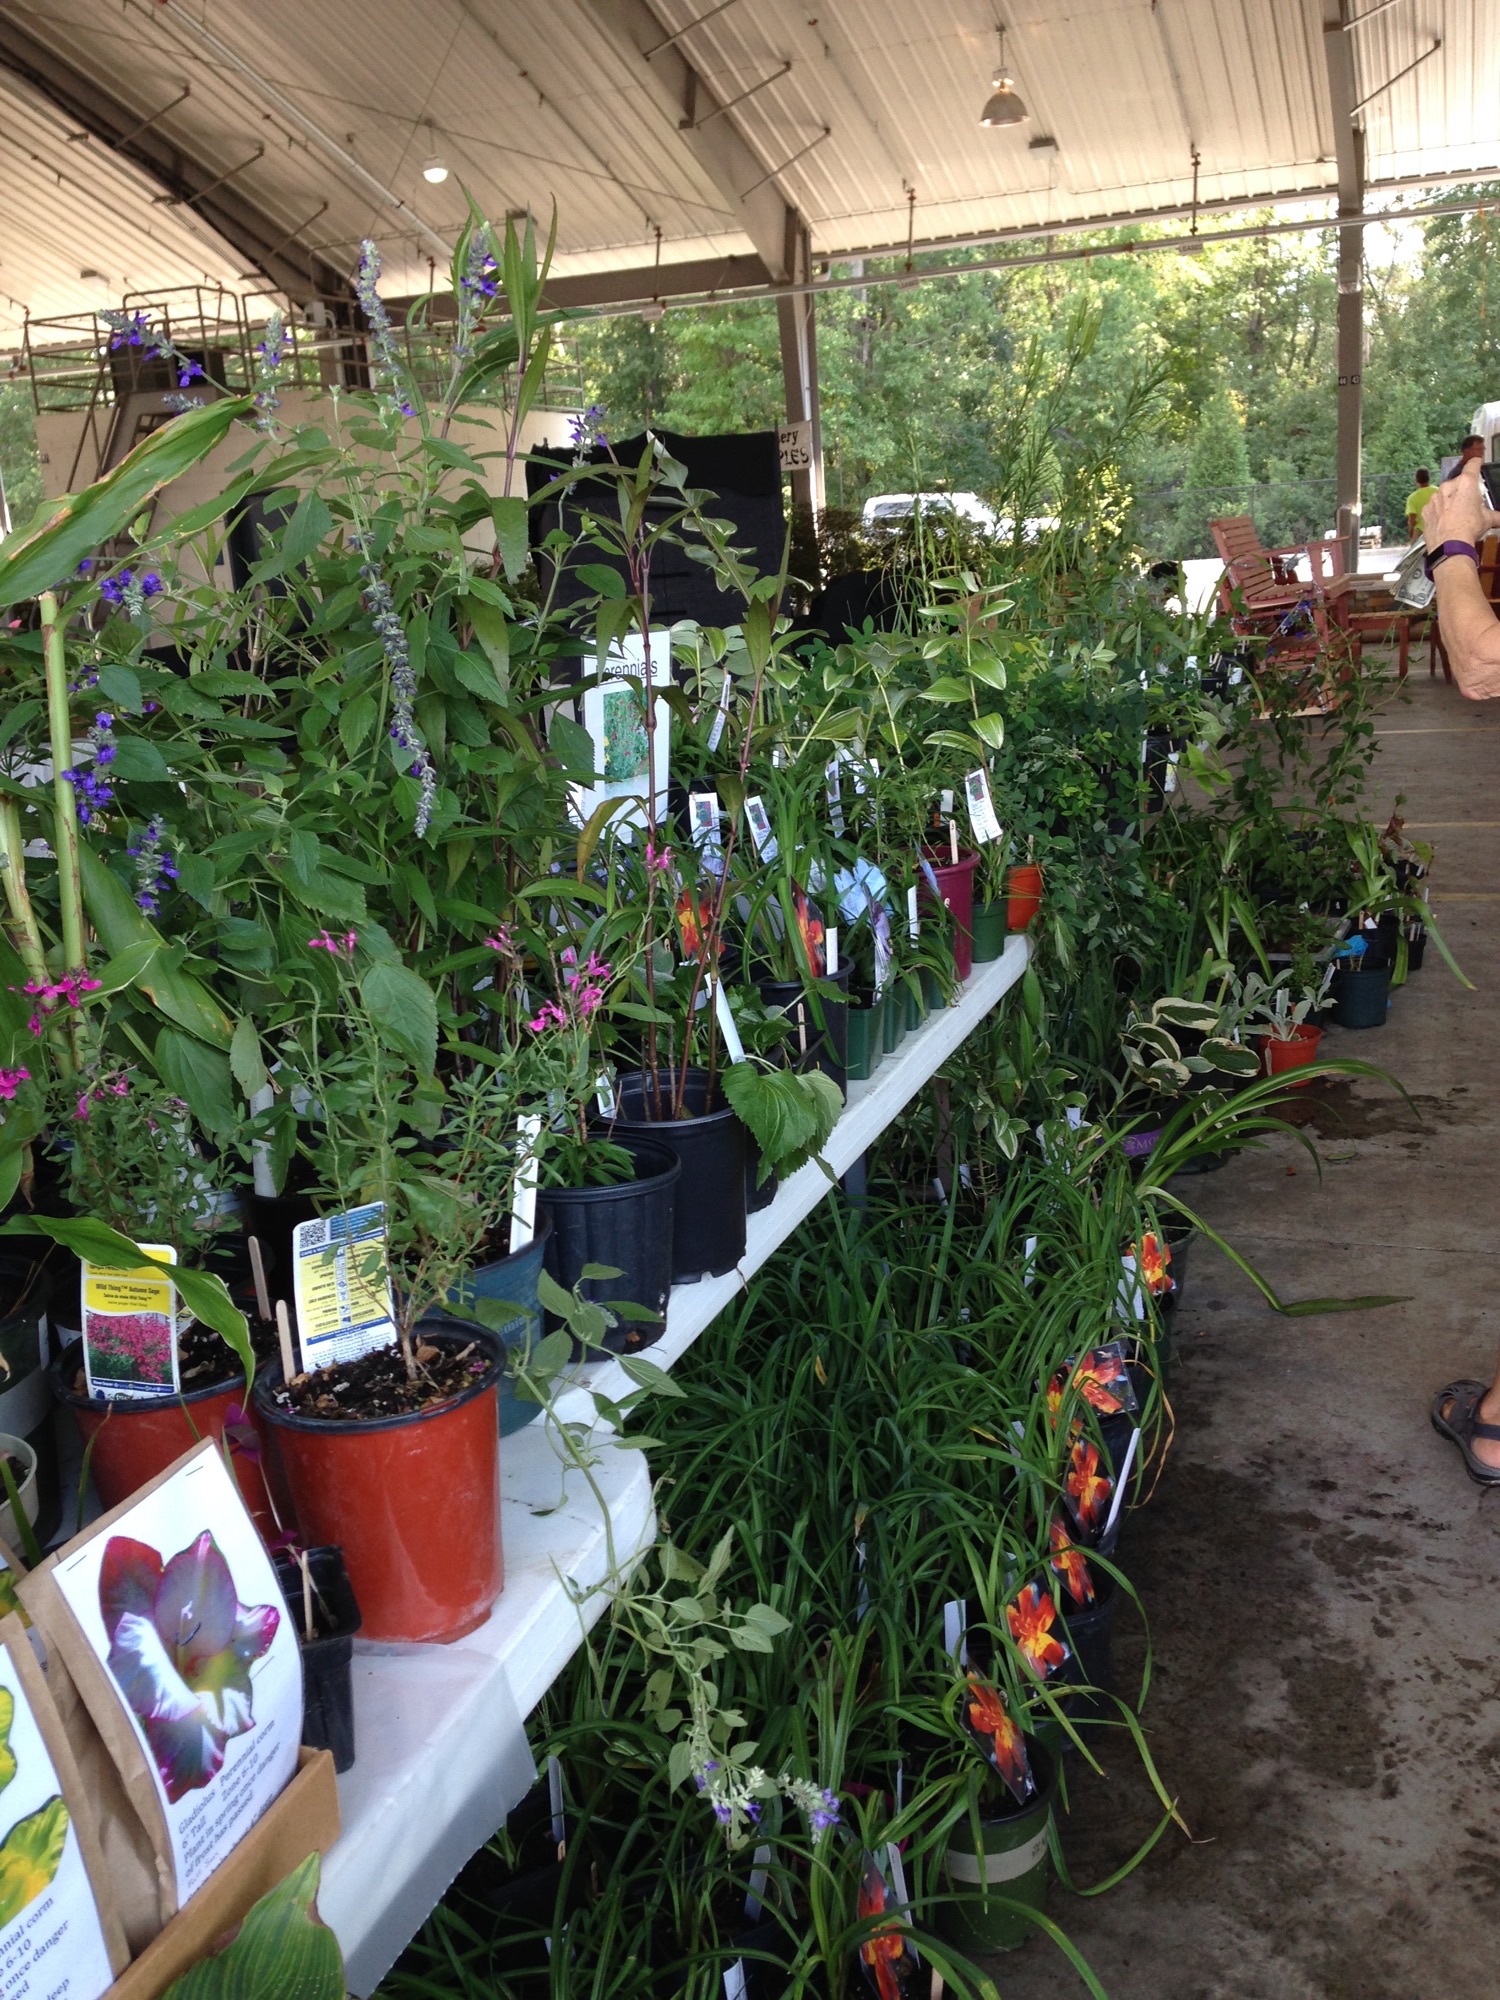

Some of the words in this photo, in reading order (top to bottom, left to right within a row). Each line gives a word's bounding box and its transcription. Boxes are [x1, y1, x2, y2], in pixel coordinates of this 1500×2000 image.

[178, 1789, 216, 1834] Gladiolus
[219, 1740, 256, 1787] Perennial
[256, 1720, 275, 1744] corm
[184, 1835, 205, 1864] Plant
[205, 1825, 214, 1839] in
[214, 1795, 240, 1828] spring
[239, 1773, 257, 1798] once
[256, 1741, 281, 1775] danger
[190, 1815, 207, 1838] Tall
[222, 1775, 241, 1802] Zone
[241, 1753, 259, 1778] 6-10
[194, 1840, 214, 1869] frost
[214, 1824, 229, 1843] has
[228, 1789, 254, 1828] passed
[26, 1897, 54, 1928] corm
[5, 1938, 32, 1969] 6-10
[5, 1961, 31, 1990] once
[32, 1920, 69, 1962] danger
